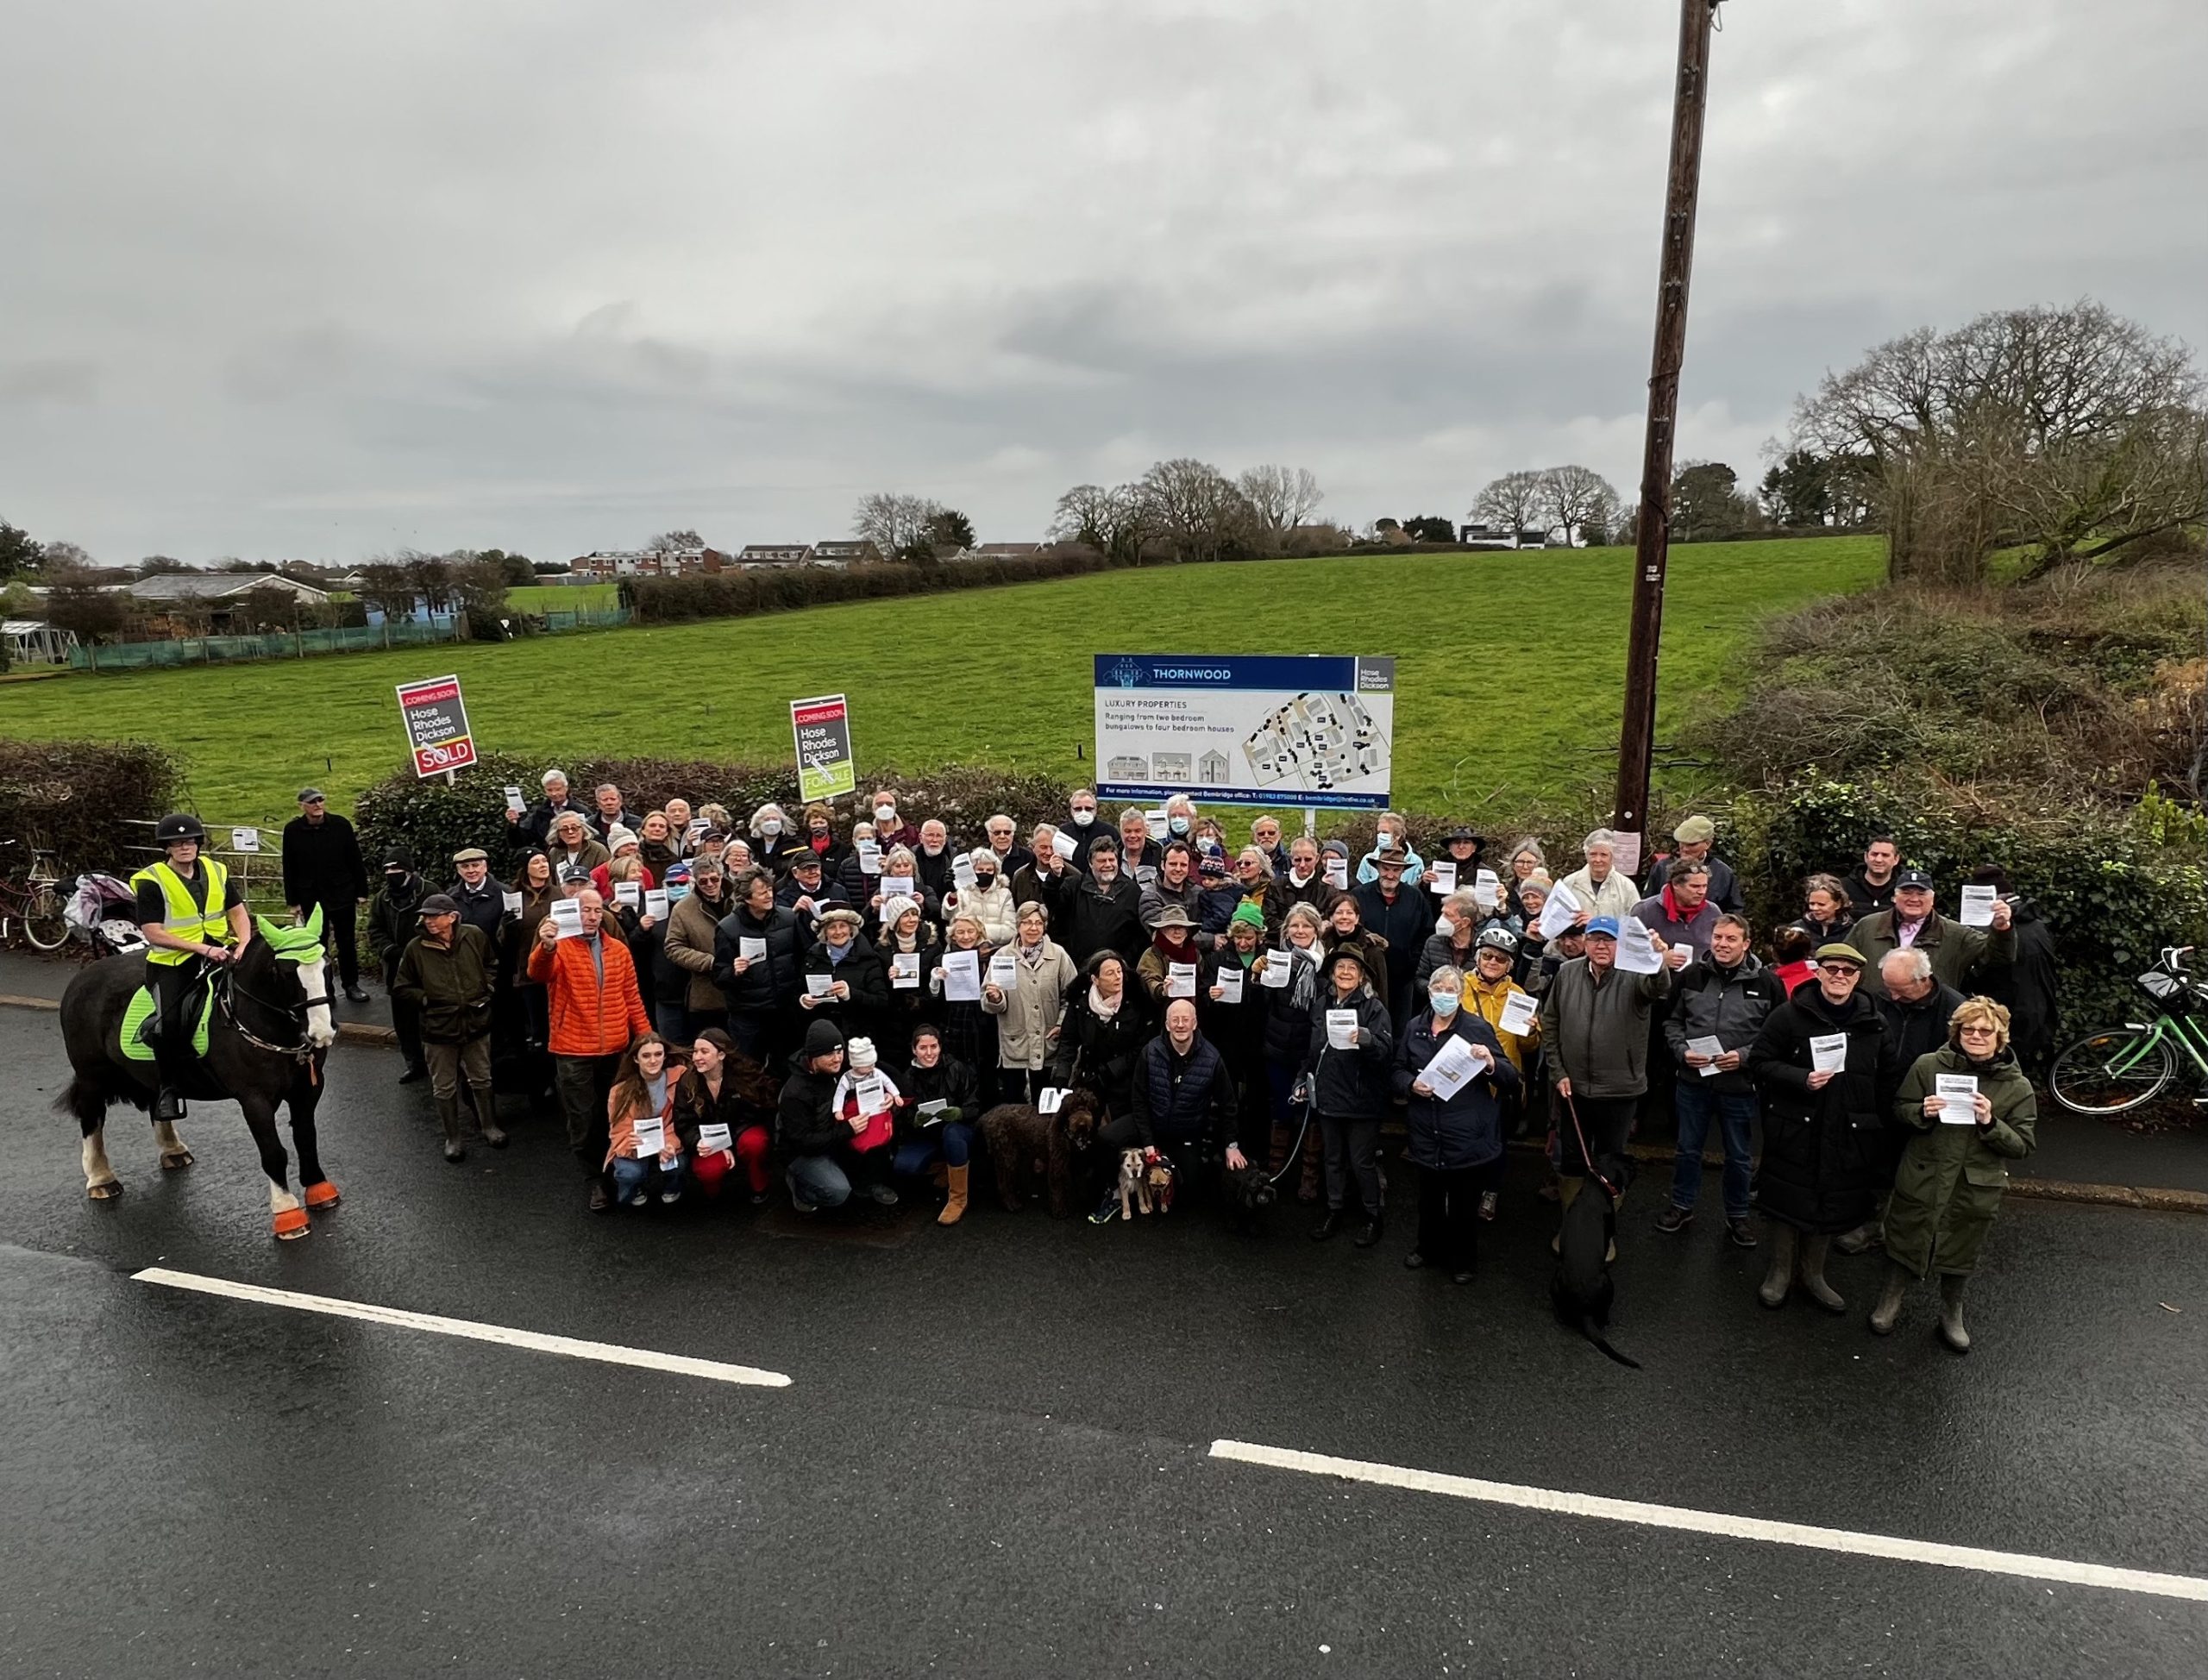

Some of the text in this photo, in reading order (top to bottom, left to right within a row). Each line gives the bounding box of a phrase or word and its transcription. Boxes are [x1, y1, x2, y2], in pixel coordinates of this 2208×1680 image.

[1153, 668, 1231, 680] THORNWOOD
[405, 689, 457, 705] COMING SOON
[1138, 700, 1188, 709] PROPERTIES
[410, 707, 439, 720] Hose
[798, 709, 844, 723] COMING SOON
[1105, 712, 1135, 722] Ranging
[412, 715, 452, 731] Rhodes
[1105, 723, 1145, 731] bungalows
[416, 725, 456, 742] Dickson
[800, 727, 826, 740] Hose
[802, 737, 837, 752] Rhodes
[421, 743, 468, 768] SOLD
[804, 748, 840, 764] Dickson
[828, 769, 850, 784] ALE
